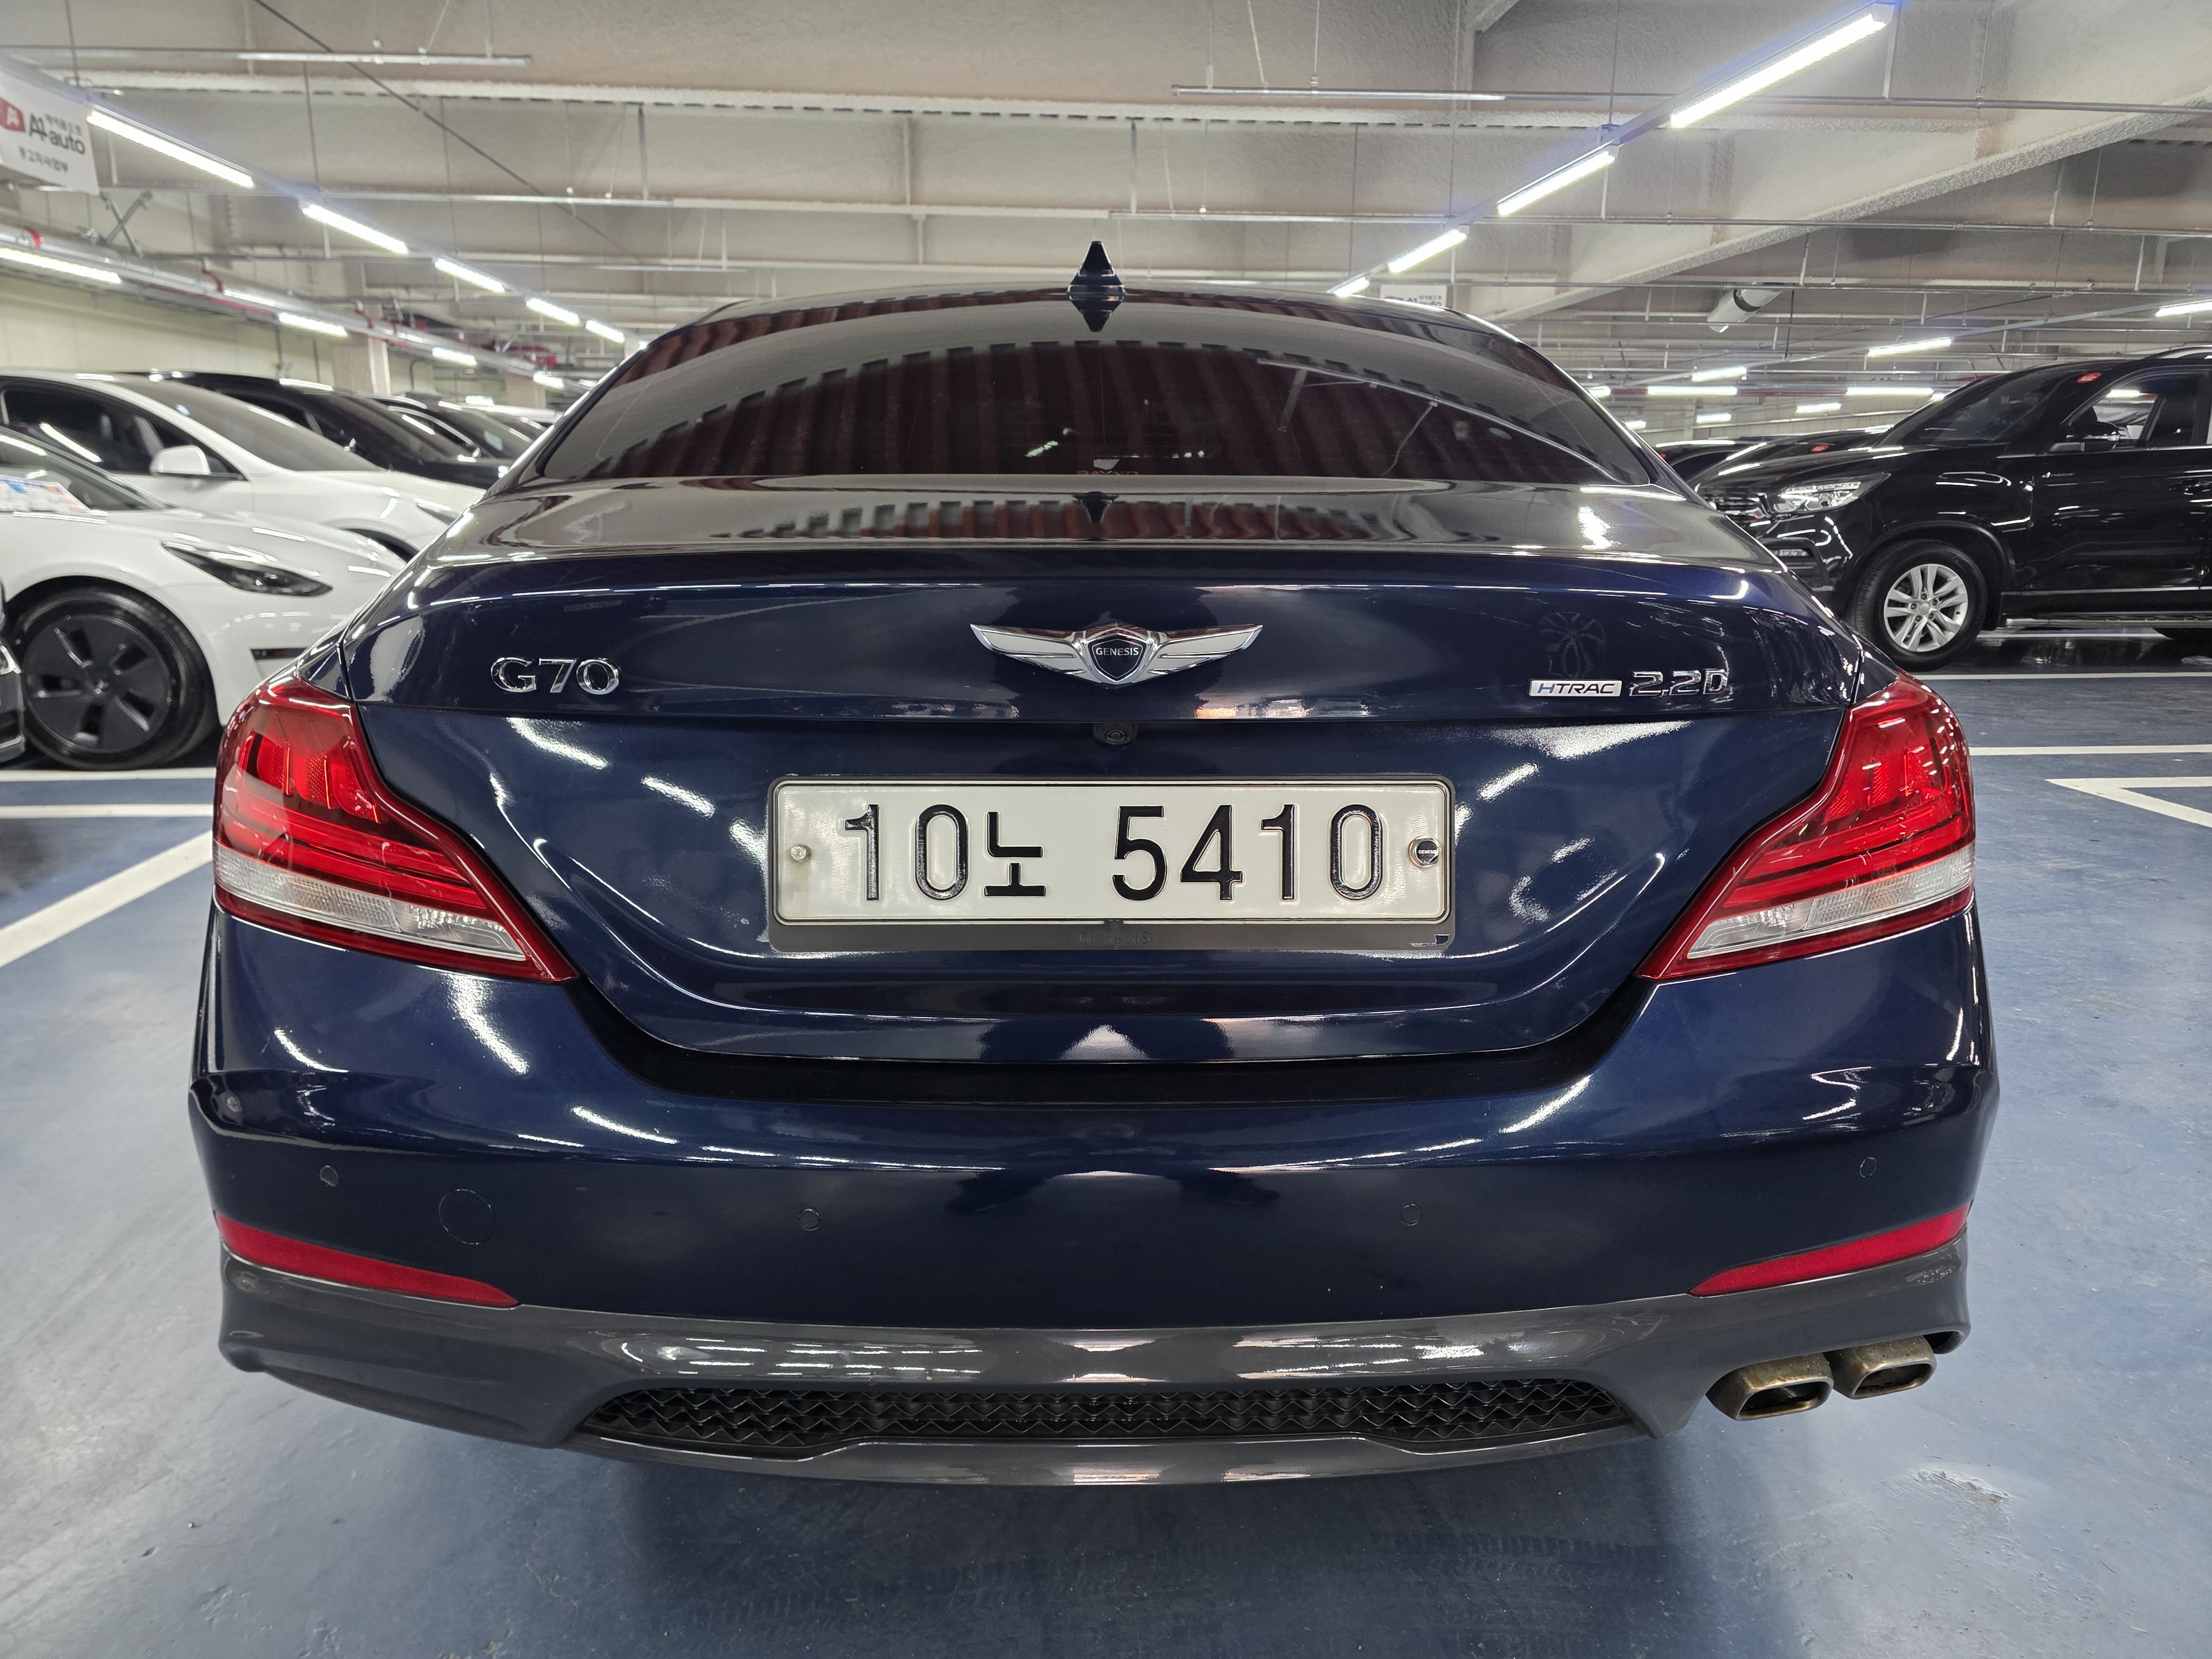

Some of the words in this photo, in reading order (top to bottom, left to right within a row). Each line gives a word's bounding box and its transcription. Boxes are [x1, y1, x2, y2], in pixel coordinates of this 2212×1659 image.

[1095, 647, 1139, 656] GENESIS
[491, 656, 622, 695] G70
[1537, 682, 1616, 695] HTRAC
[1629, 669, 1729, 697] 2.2D
[843, 803, 1047, 902] 10노
[1111, 803, 1382, 902] 5410
[1078, 931, 1151, 945] GENESIS
